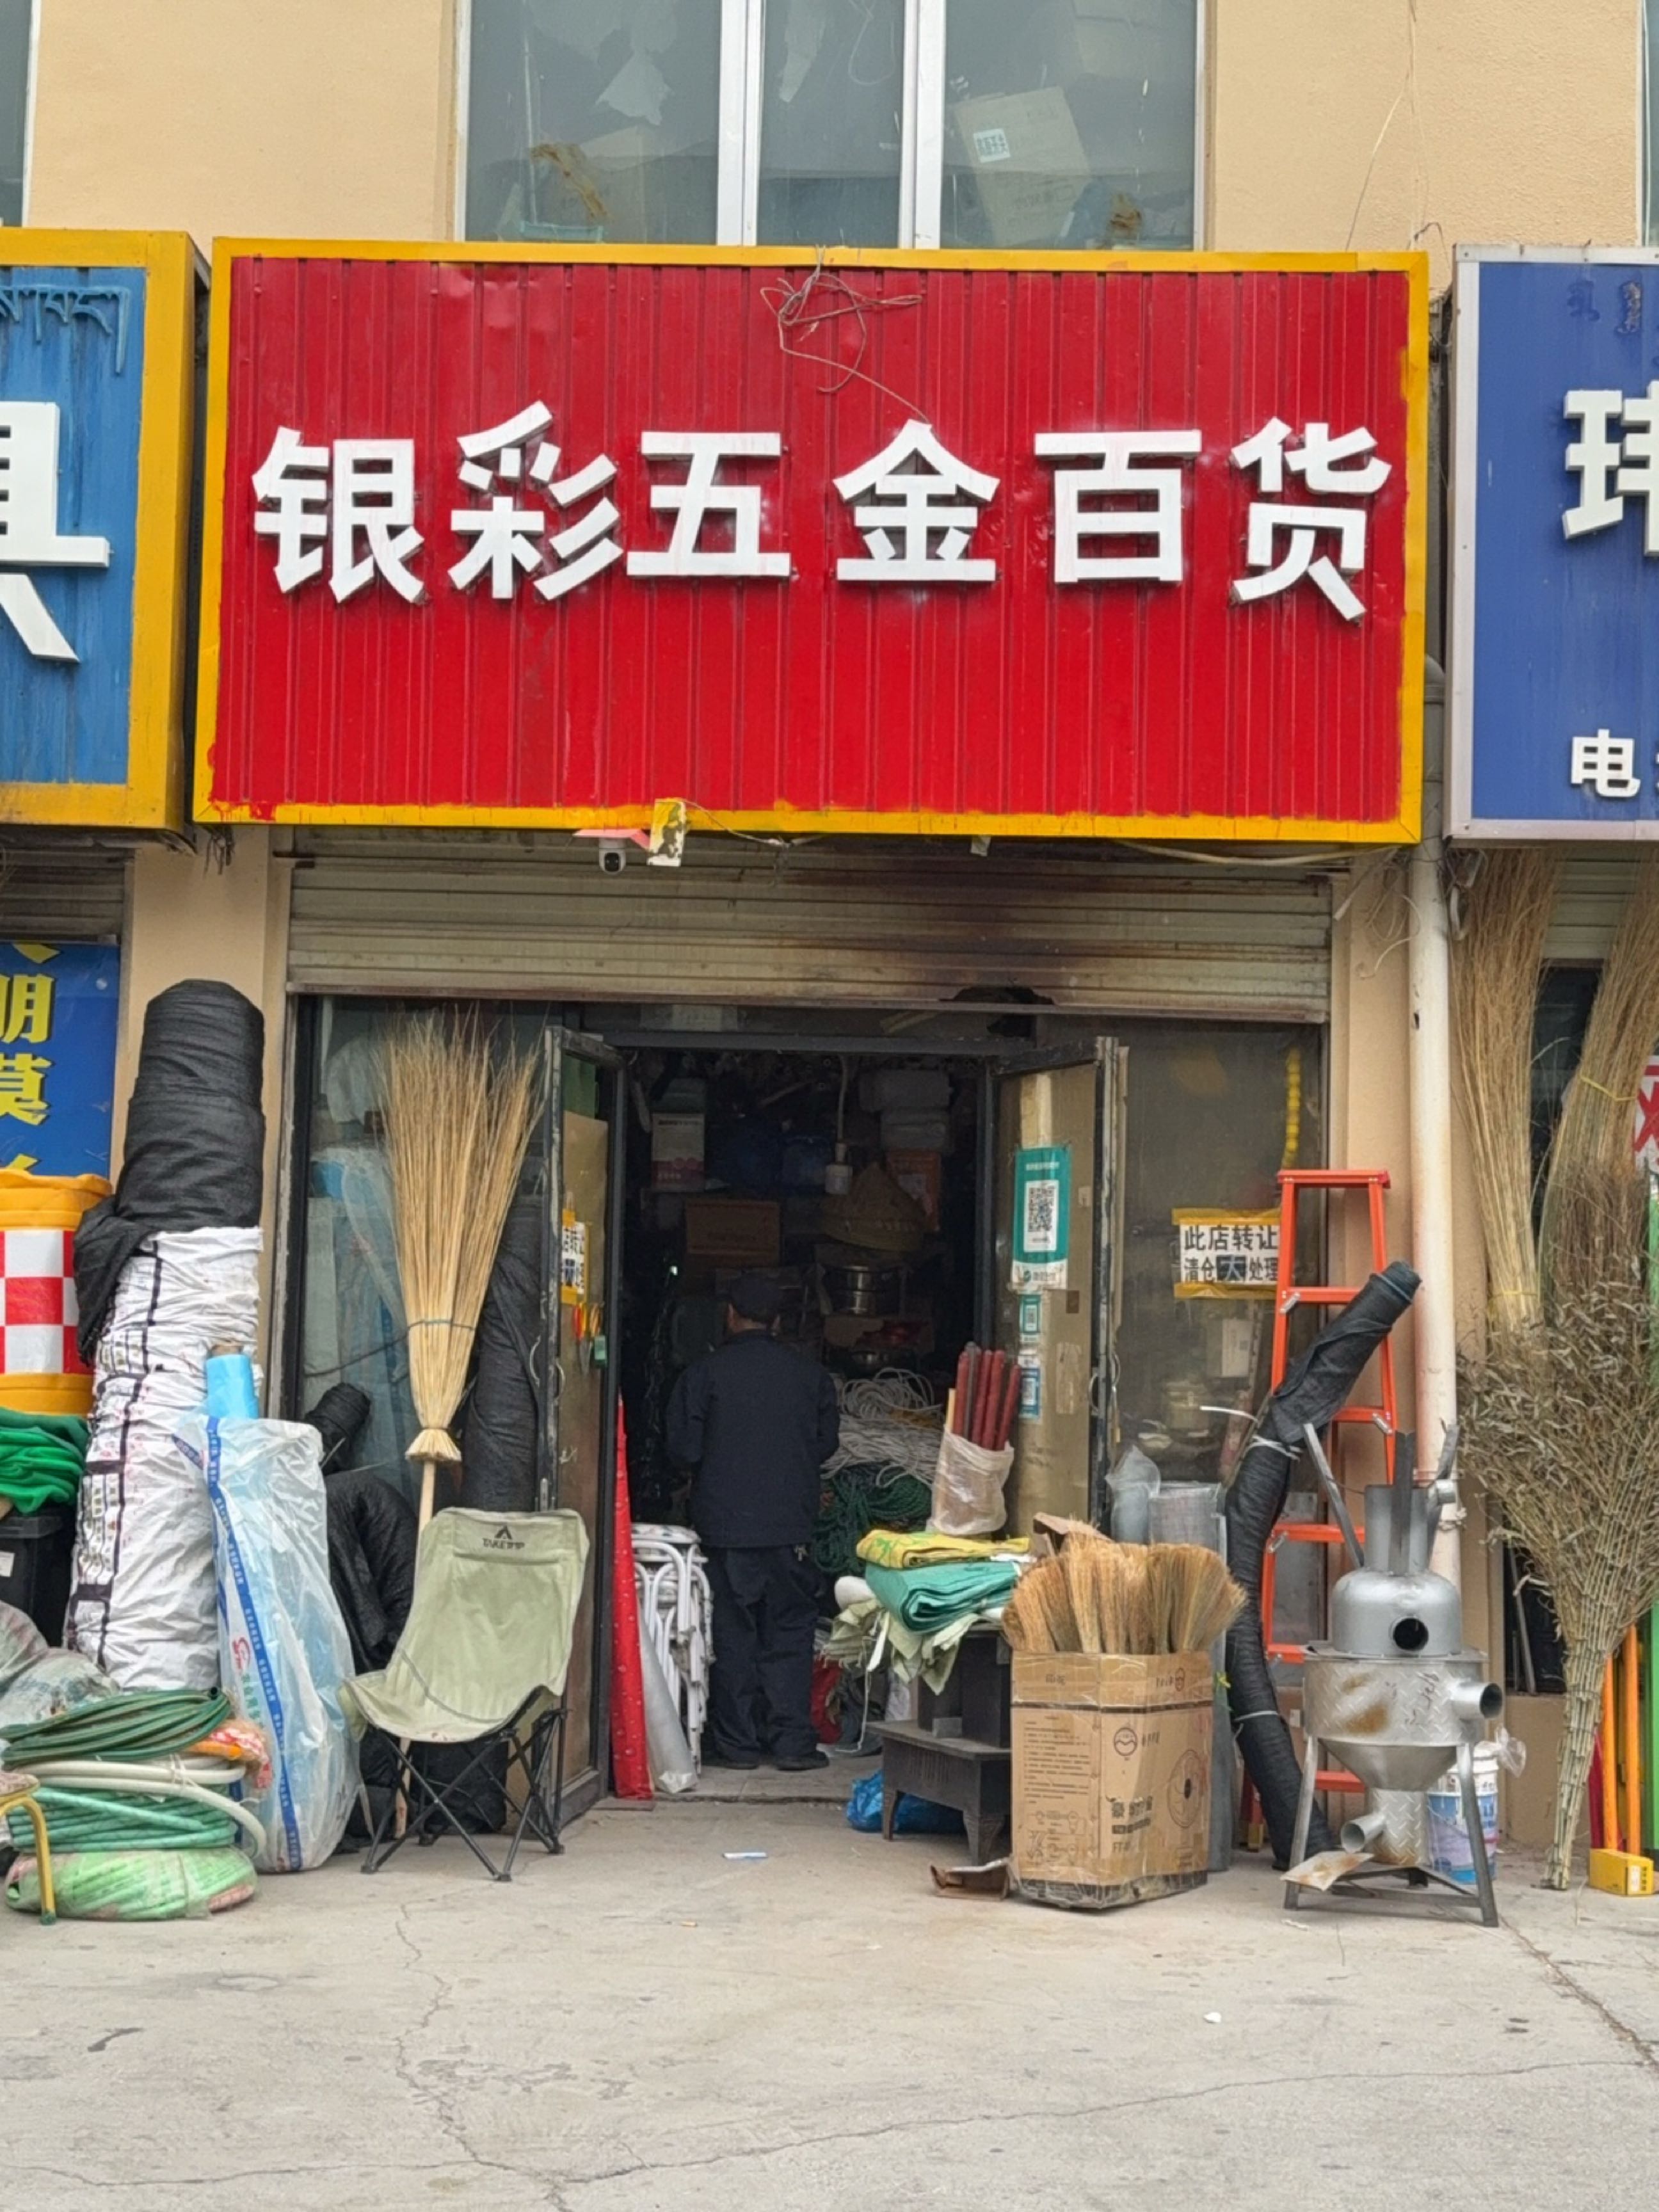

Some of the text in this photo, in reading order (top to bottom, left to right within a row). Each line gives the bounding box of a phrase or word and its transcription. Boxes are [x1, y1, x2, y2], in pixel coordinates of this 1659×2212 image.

[252, 400, 1393, 623] 银彩五金百货
[1570, 727, 1659, 797] 电
[1185, 1224, 1278, 1251] 此店转让
[1185, 1255, 1279, 1281] 清仓大处理
